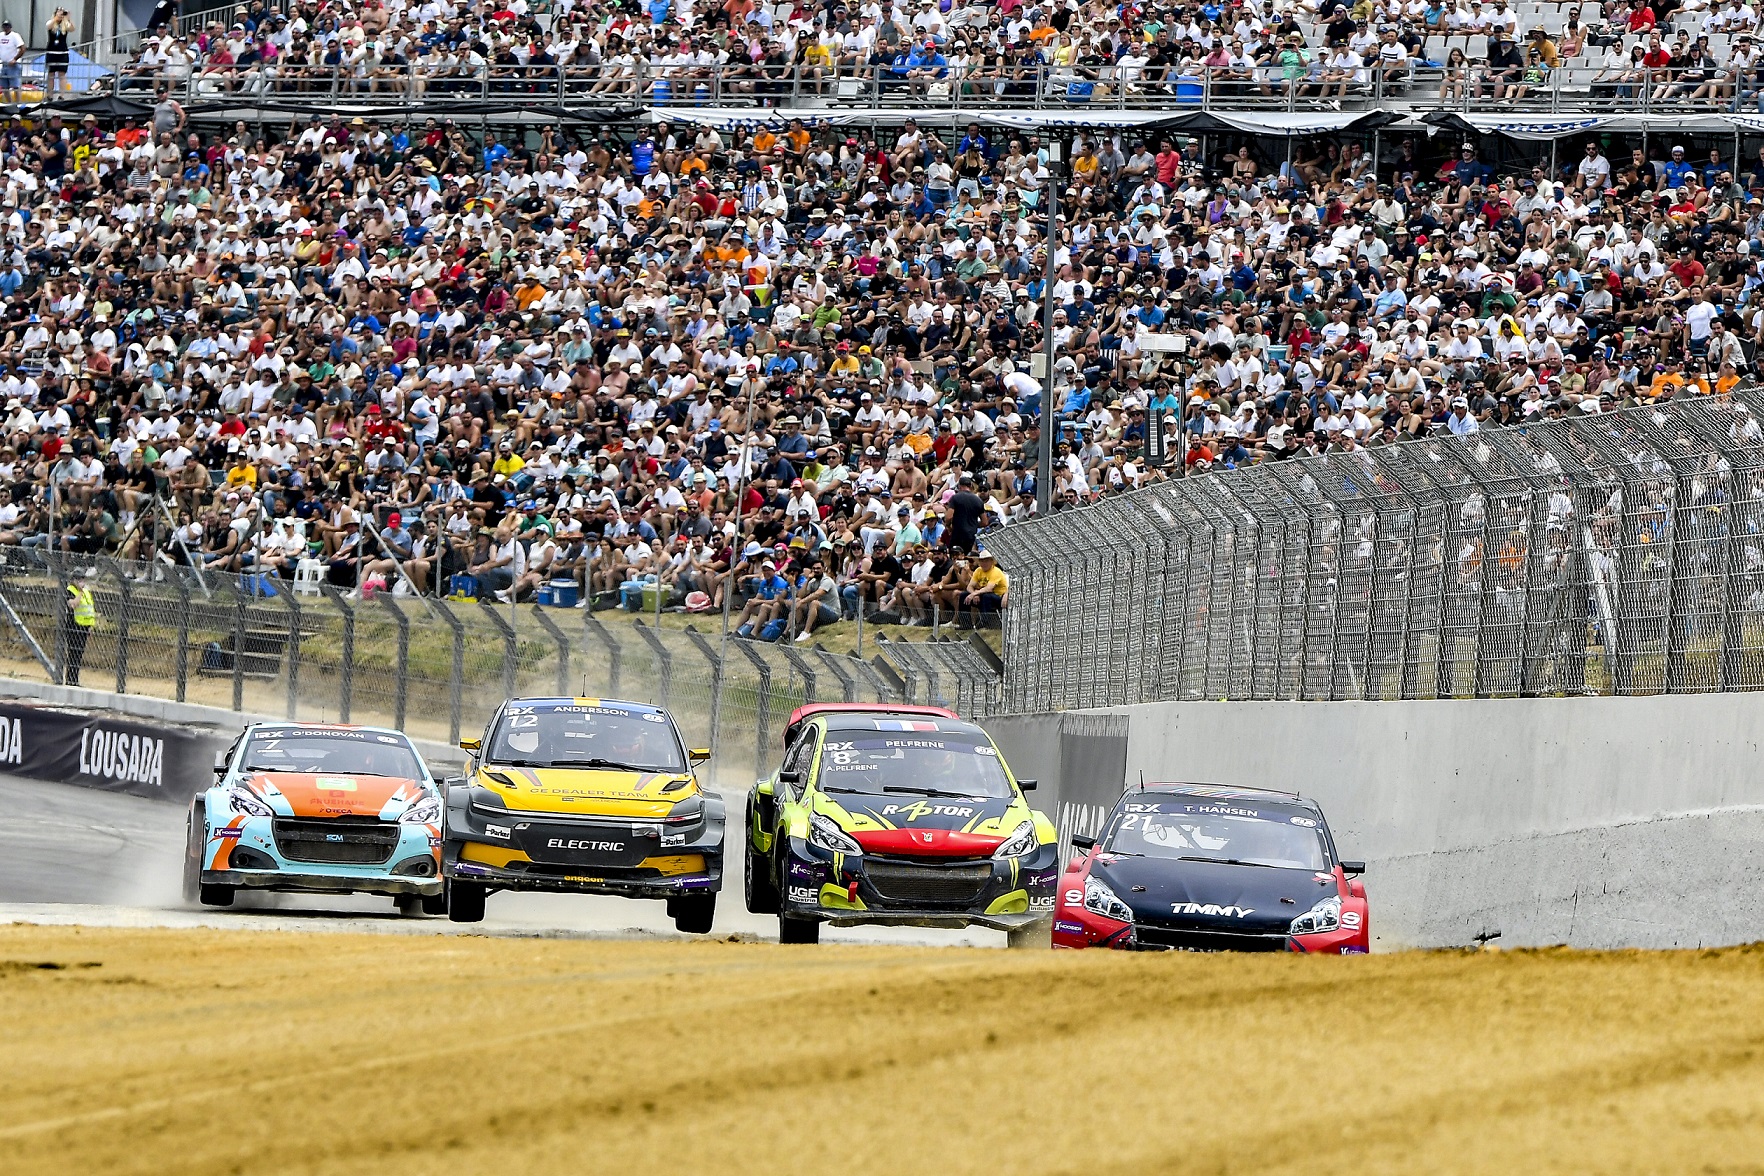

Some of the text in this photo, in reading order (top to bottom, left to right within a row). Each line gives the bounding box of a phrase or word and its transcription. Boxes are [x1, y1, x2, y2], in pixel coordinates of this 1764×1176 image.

[553, 706, 629, 717] ANDERSSON
[508, 715, 539, 729] 12
[292, 730, 365, 740] O'DONOVAN
[264, 739, 281, 750] 7
[885, 740, 945, 749] PELFRENE
[79, 727, 164, 786] LOUSADA
[833, 750, 851, 765] 8
[826, 764, 878, 772] A.PELFRENE
[551, 788, 605, 796] DEALER
[1199, 806, 1259, 817] HANSEN
[1120, 813, 1153, 832] 21
[489, 828, 510, 838] Parker
[547, 839, 625, 852] ELECTRIC
[789, 885, 818, 898] UGF
[1029, 896, 1056, 906] UGF
[1170, 902, 1256, 918] TIMMY
